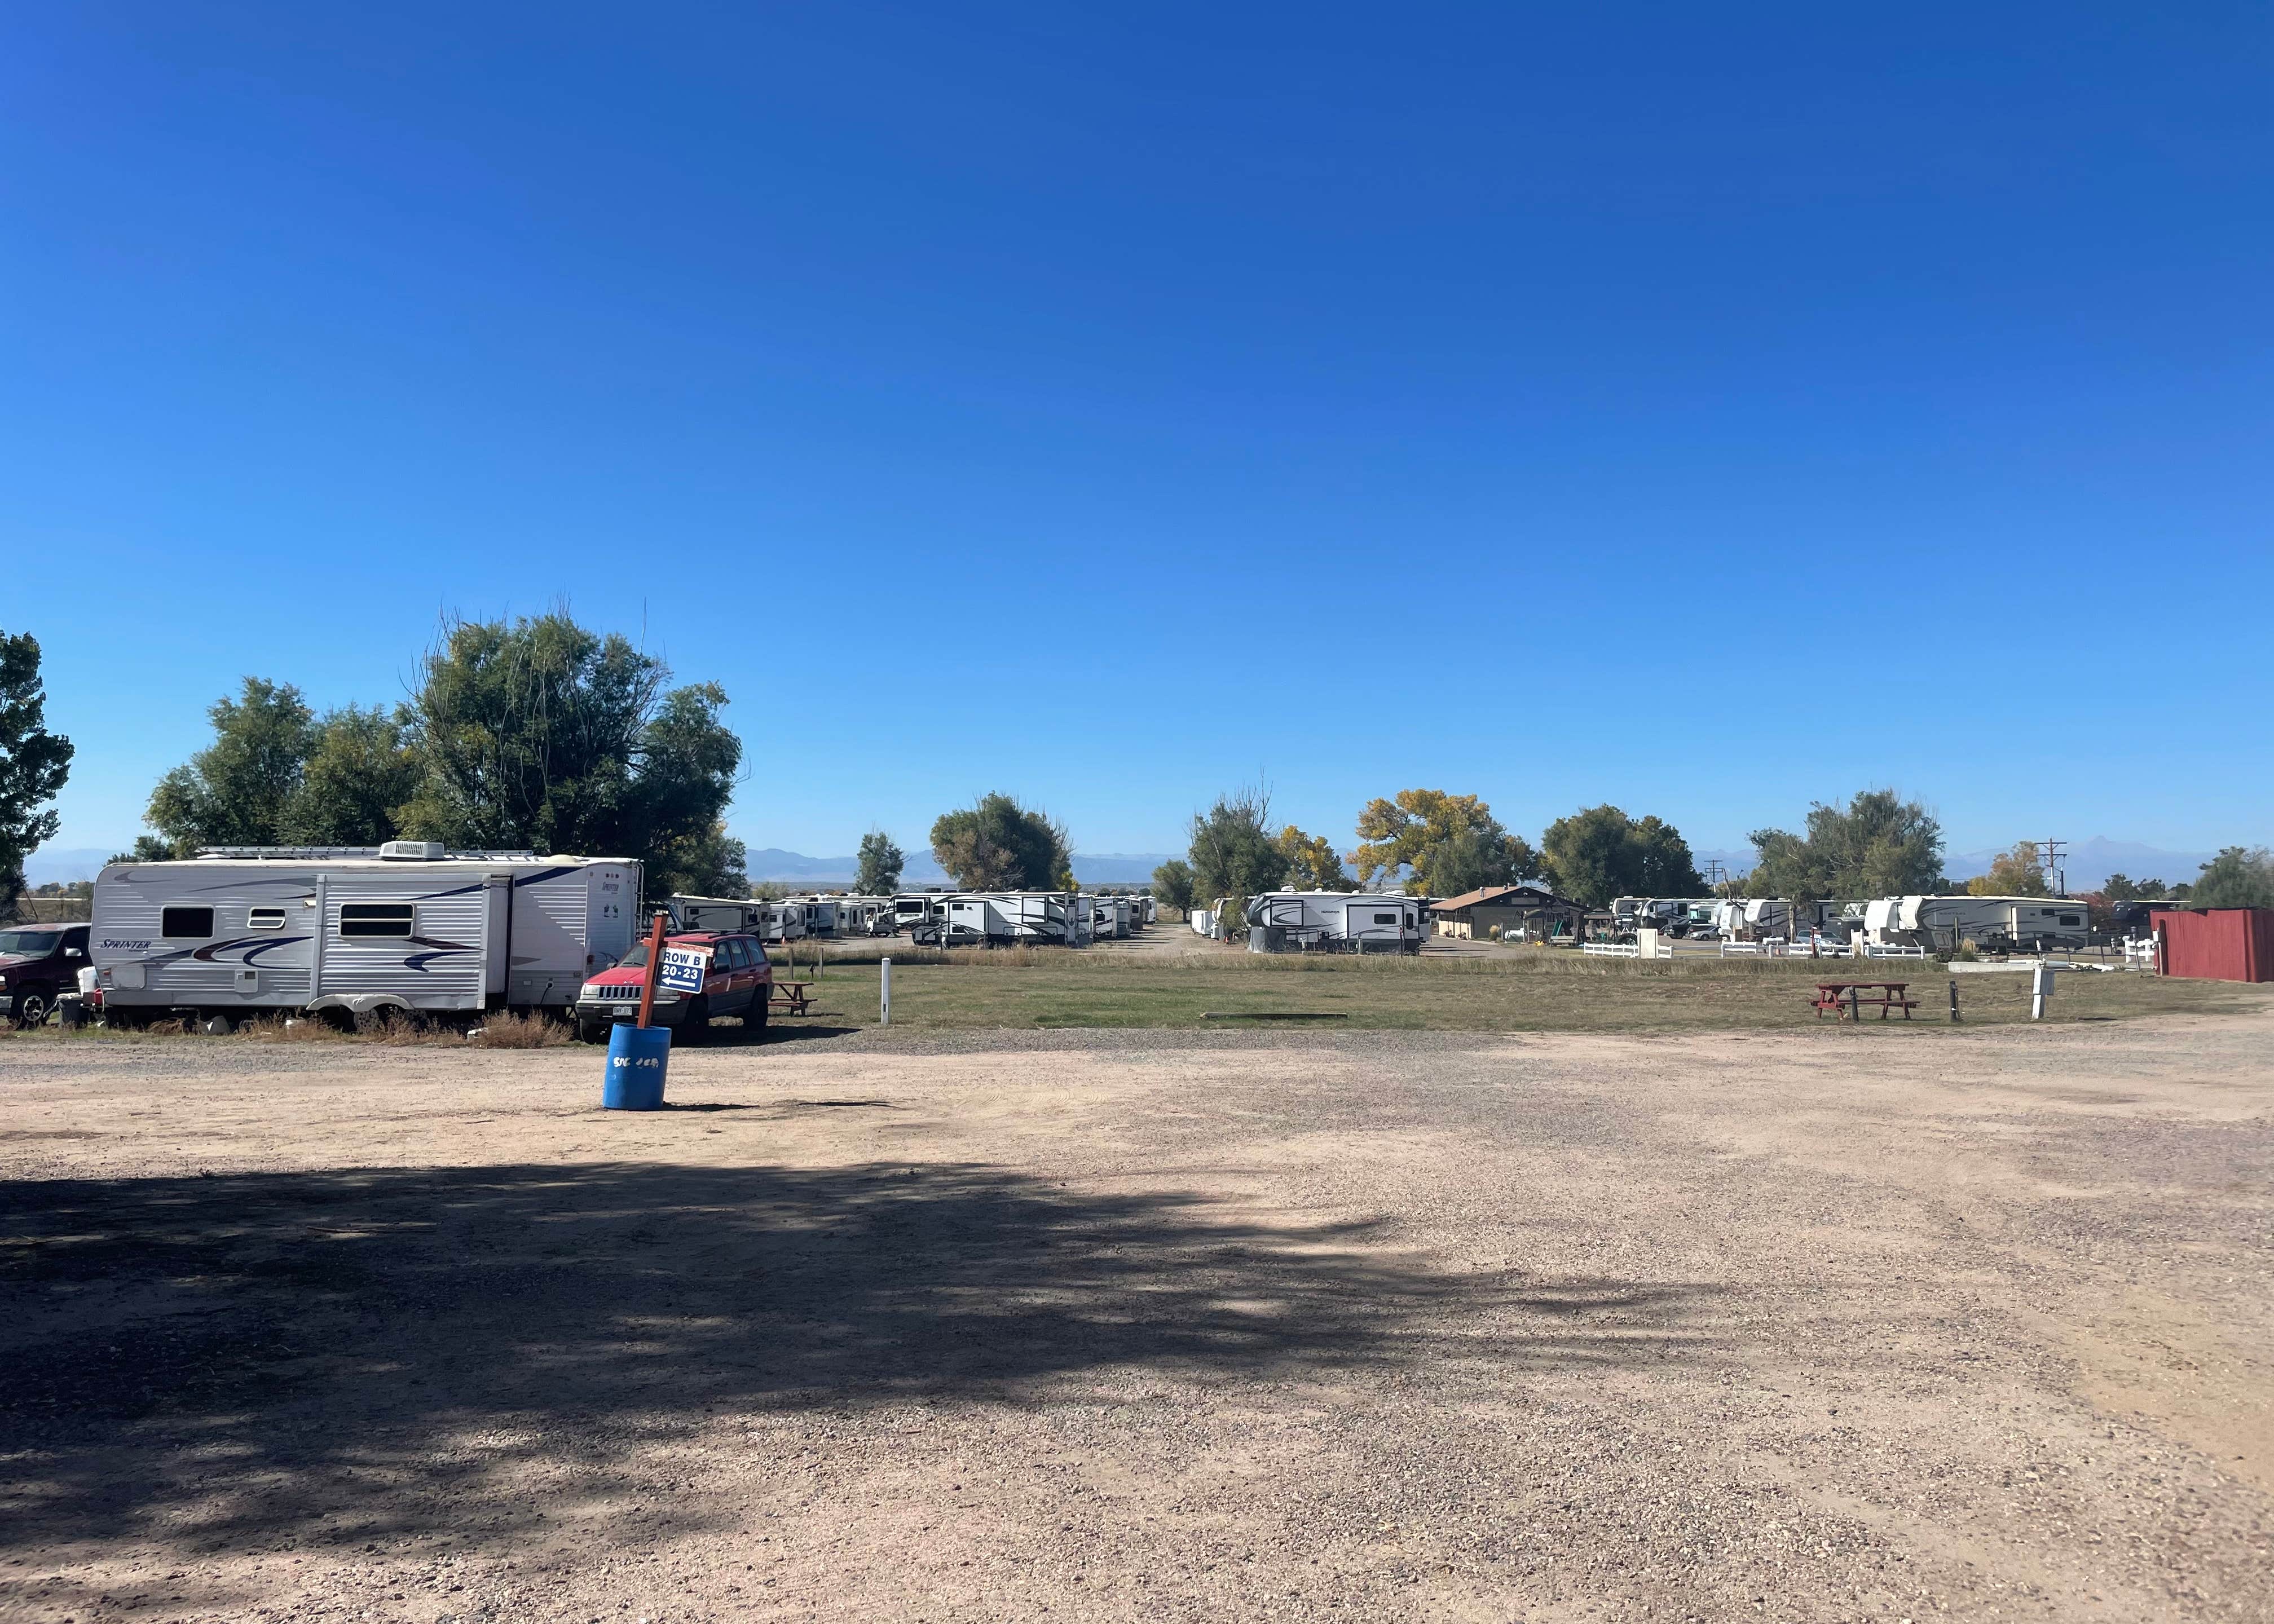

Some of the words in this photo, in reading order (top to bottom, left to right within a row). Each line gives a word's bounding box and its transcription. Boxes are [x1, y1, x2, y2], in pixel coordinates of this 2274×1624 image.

[100, 939, 152, 948] SPRINTER
[664, 952, 689, 964] ROW
[693, 956, 700, 965] B
[662, 964, 698, 979] 20-23
